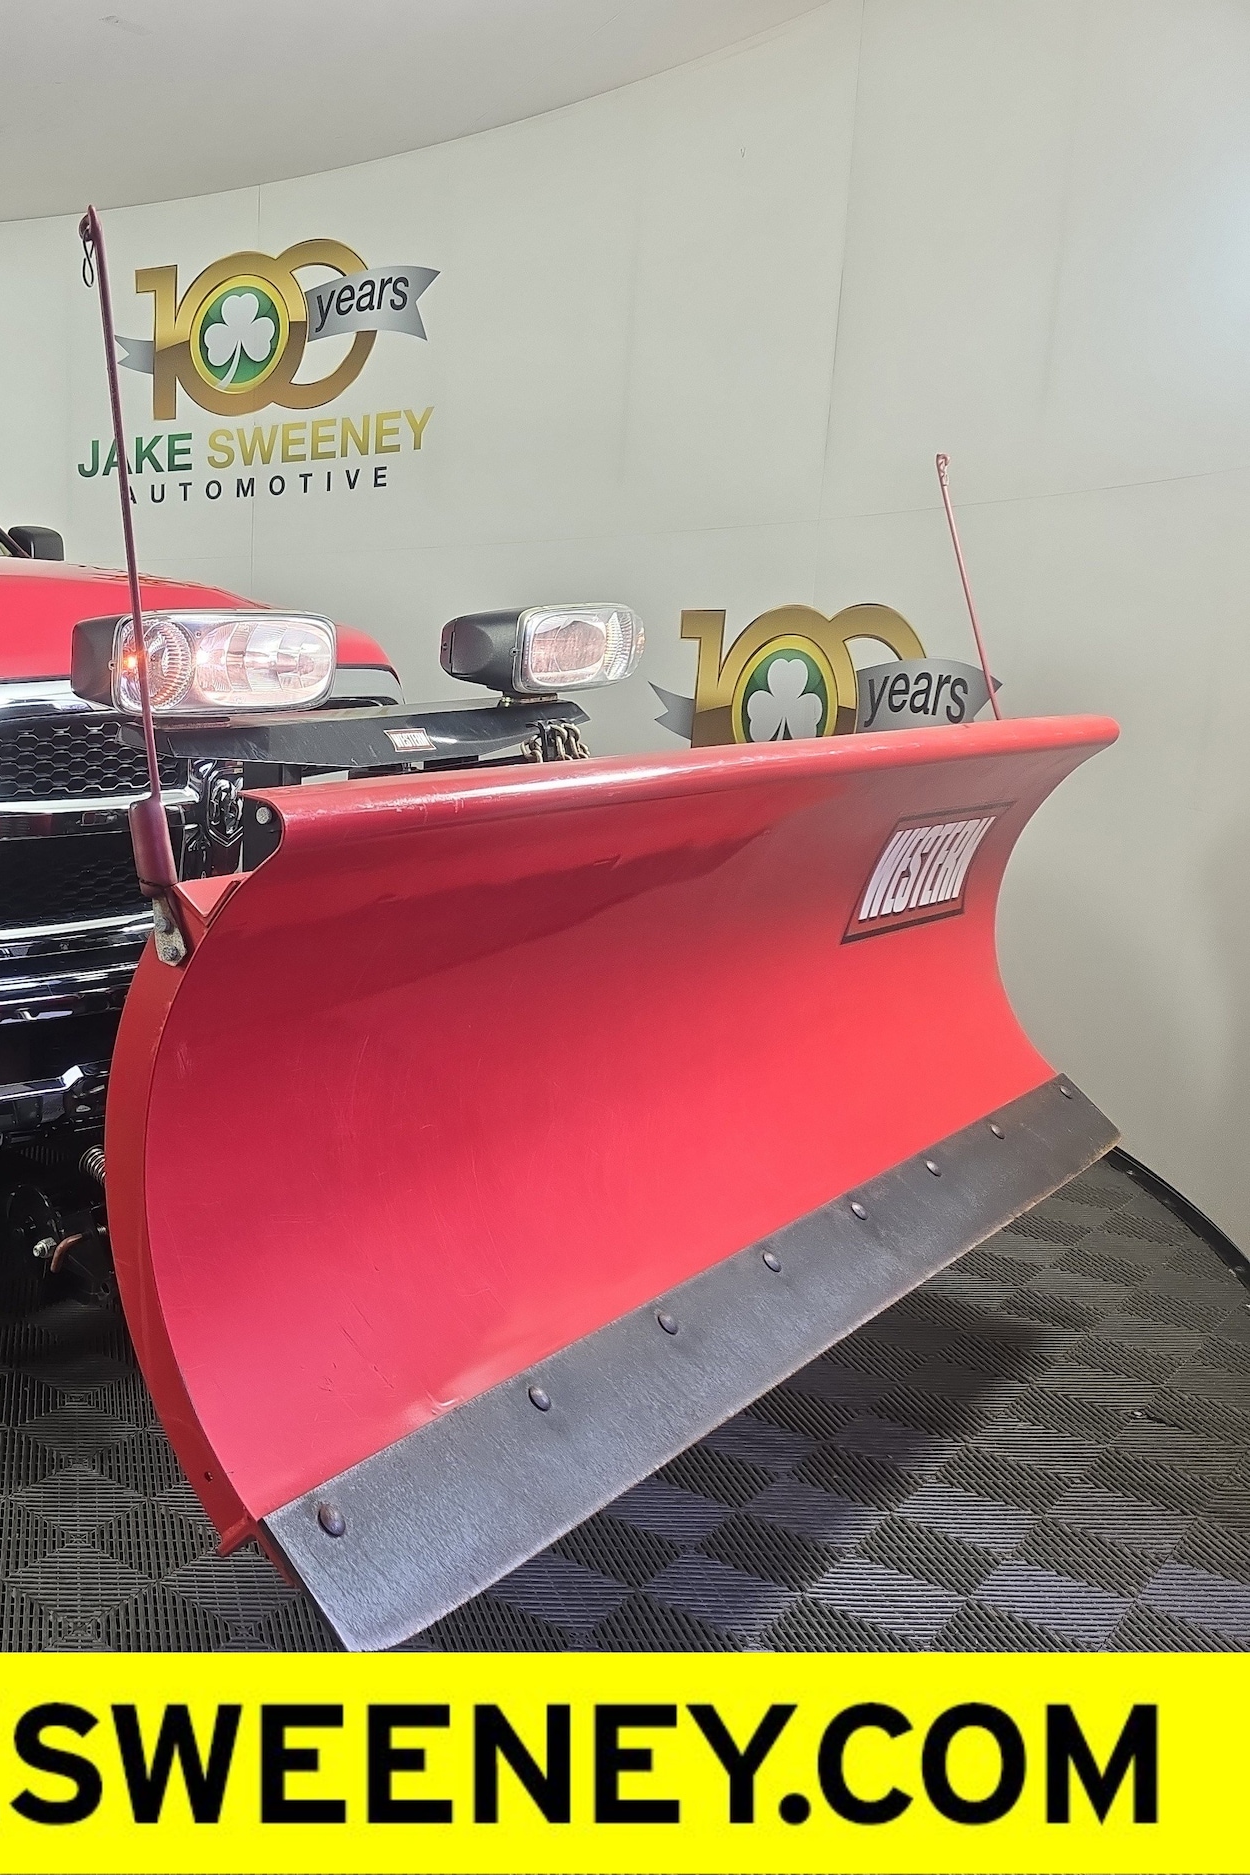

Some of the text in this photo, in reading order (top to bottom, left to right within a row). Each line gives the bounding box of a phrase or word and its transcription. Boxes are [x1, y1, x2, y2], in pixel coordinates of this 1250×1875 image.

[315, 275, 409, 333] years
[78, 406, 435, 478] JAKE SWEENEY
[863, 671, 969, 728] years
[858, 815, 997, 923] WESTERN
